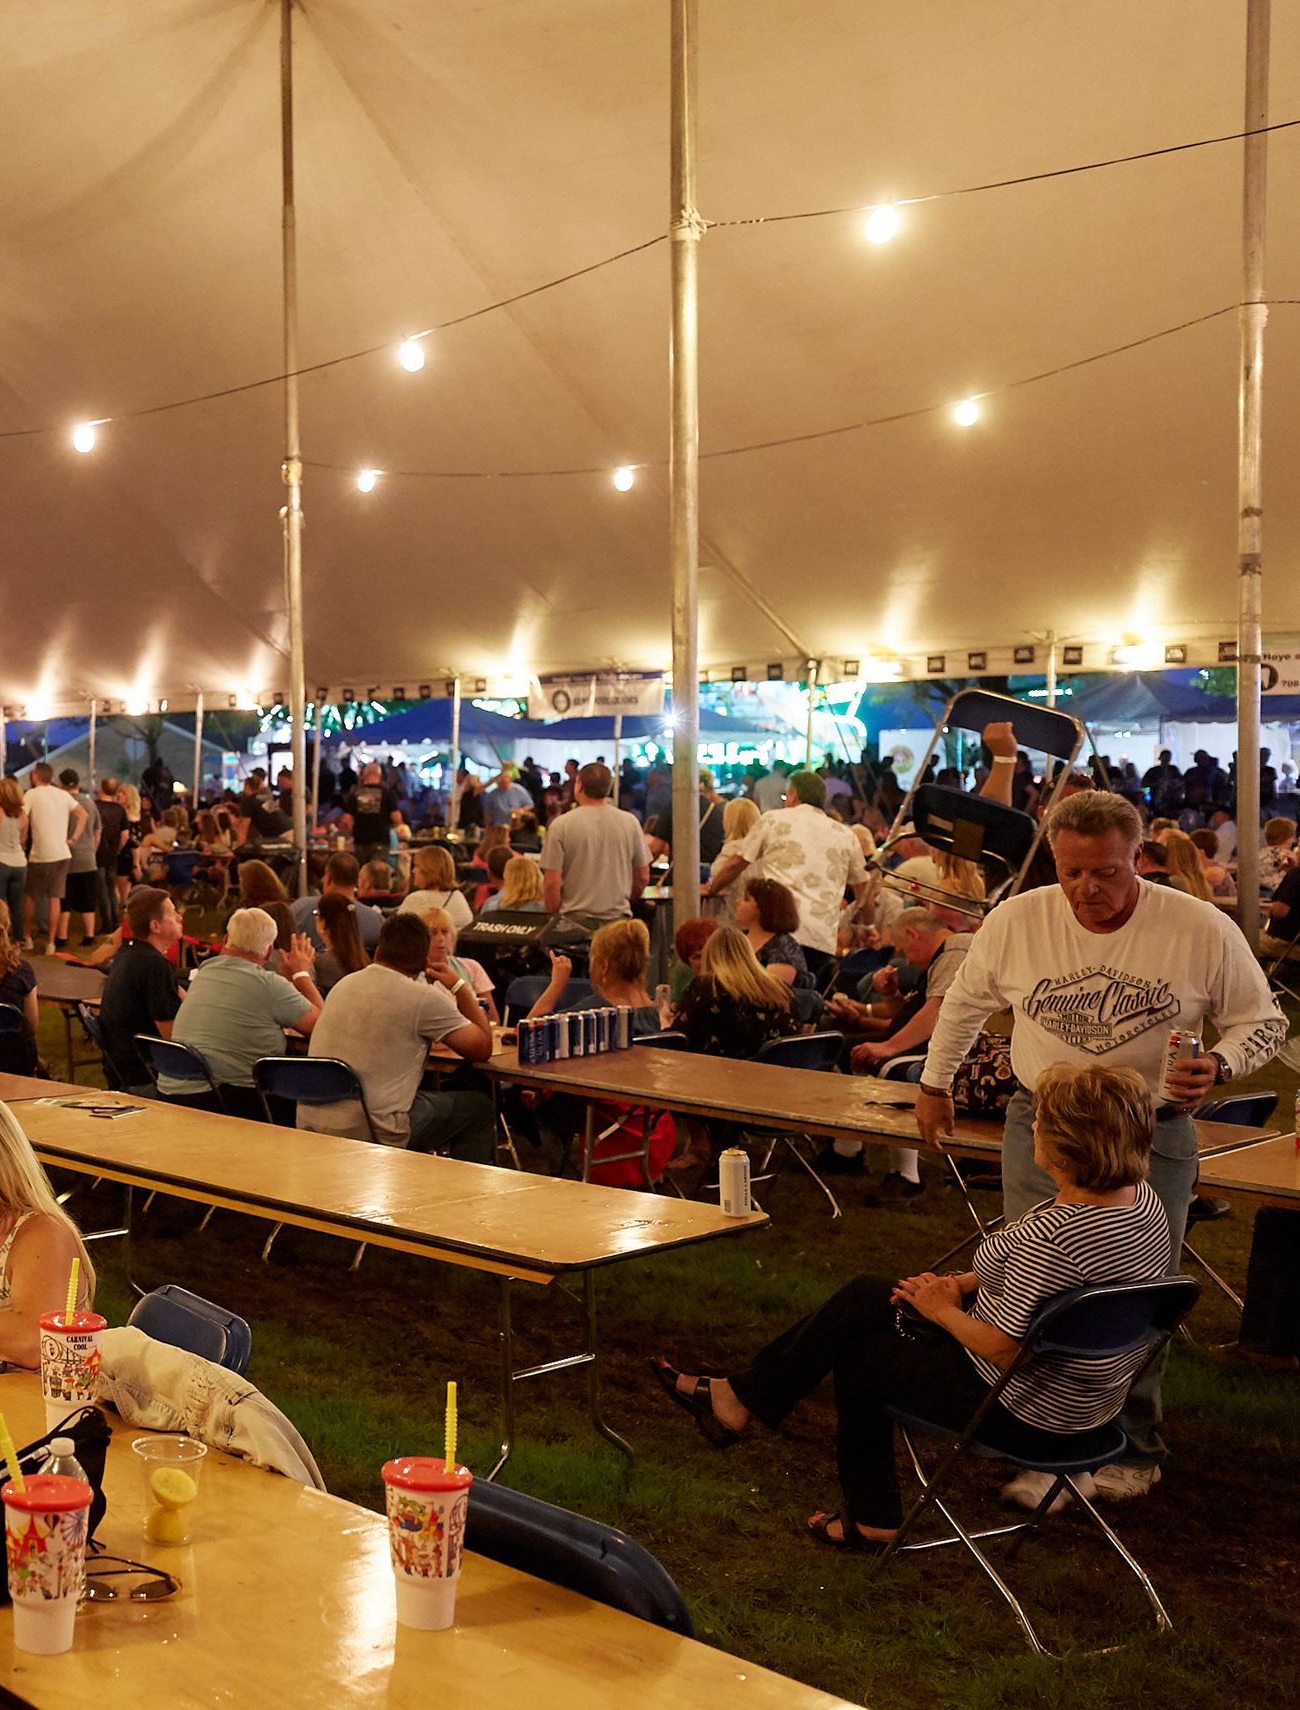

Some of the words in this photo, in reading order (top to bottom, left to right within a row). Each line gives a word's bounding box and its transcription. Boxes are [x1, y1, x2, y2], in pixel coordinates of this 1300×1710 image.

[473, 922, 509, 933] TRASH
[506, 925, 537, 935] ONLY
[1027, 979, 1101, 1021] Genuine
[1098, 978, 1174, 1026] Classic
[1095, 1008, 1175, 1053] MOTORCYCLES
